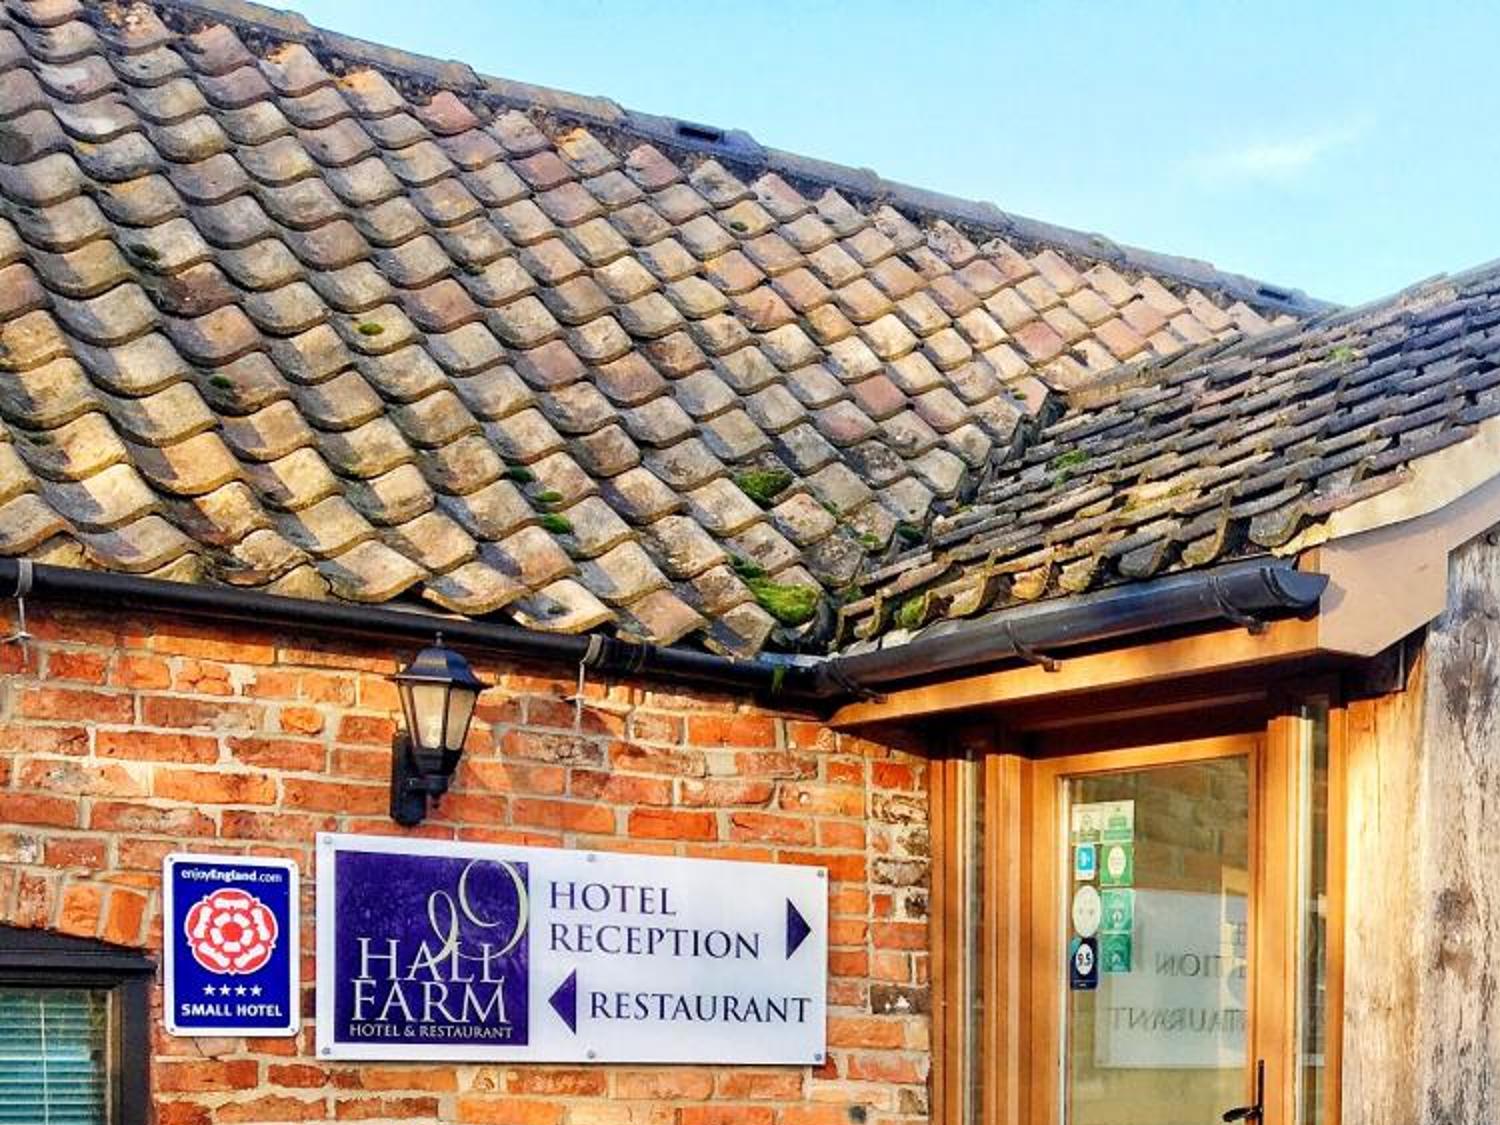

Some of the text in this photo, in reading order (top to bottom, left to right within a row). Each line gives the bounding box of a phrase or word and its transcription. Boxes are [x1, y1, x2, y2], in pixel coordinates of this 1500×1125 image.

[181, 868, 283, 883] enjoyEngland.com
[550, 881, 677, 916] HOTEL
[550, 923, 759, 960] RECEPTION
[357, 937, 505, 983] HALL
[181, 1003, 283, 1017] SMALL HOTEL
[351, 979, 511, 1024] FARM
[590, 991, 812, 1023] RESTAURANT
[350, 1024, 513, 1039] HOTEL & RESTAURANT
